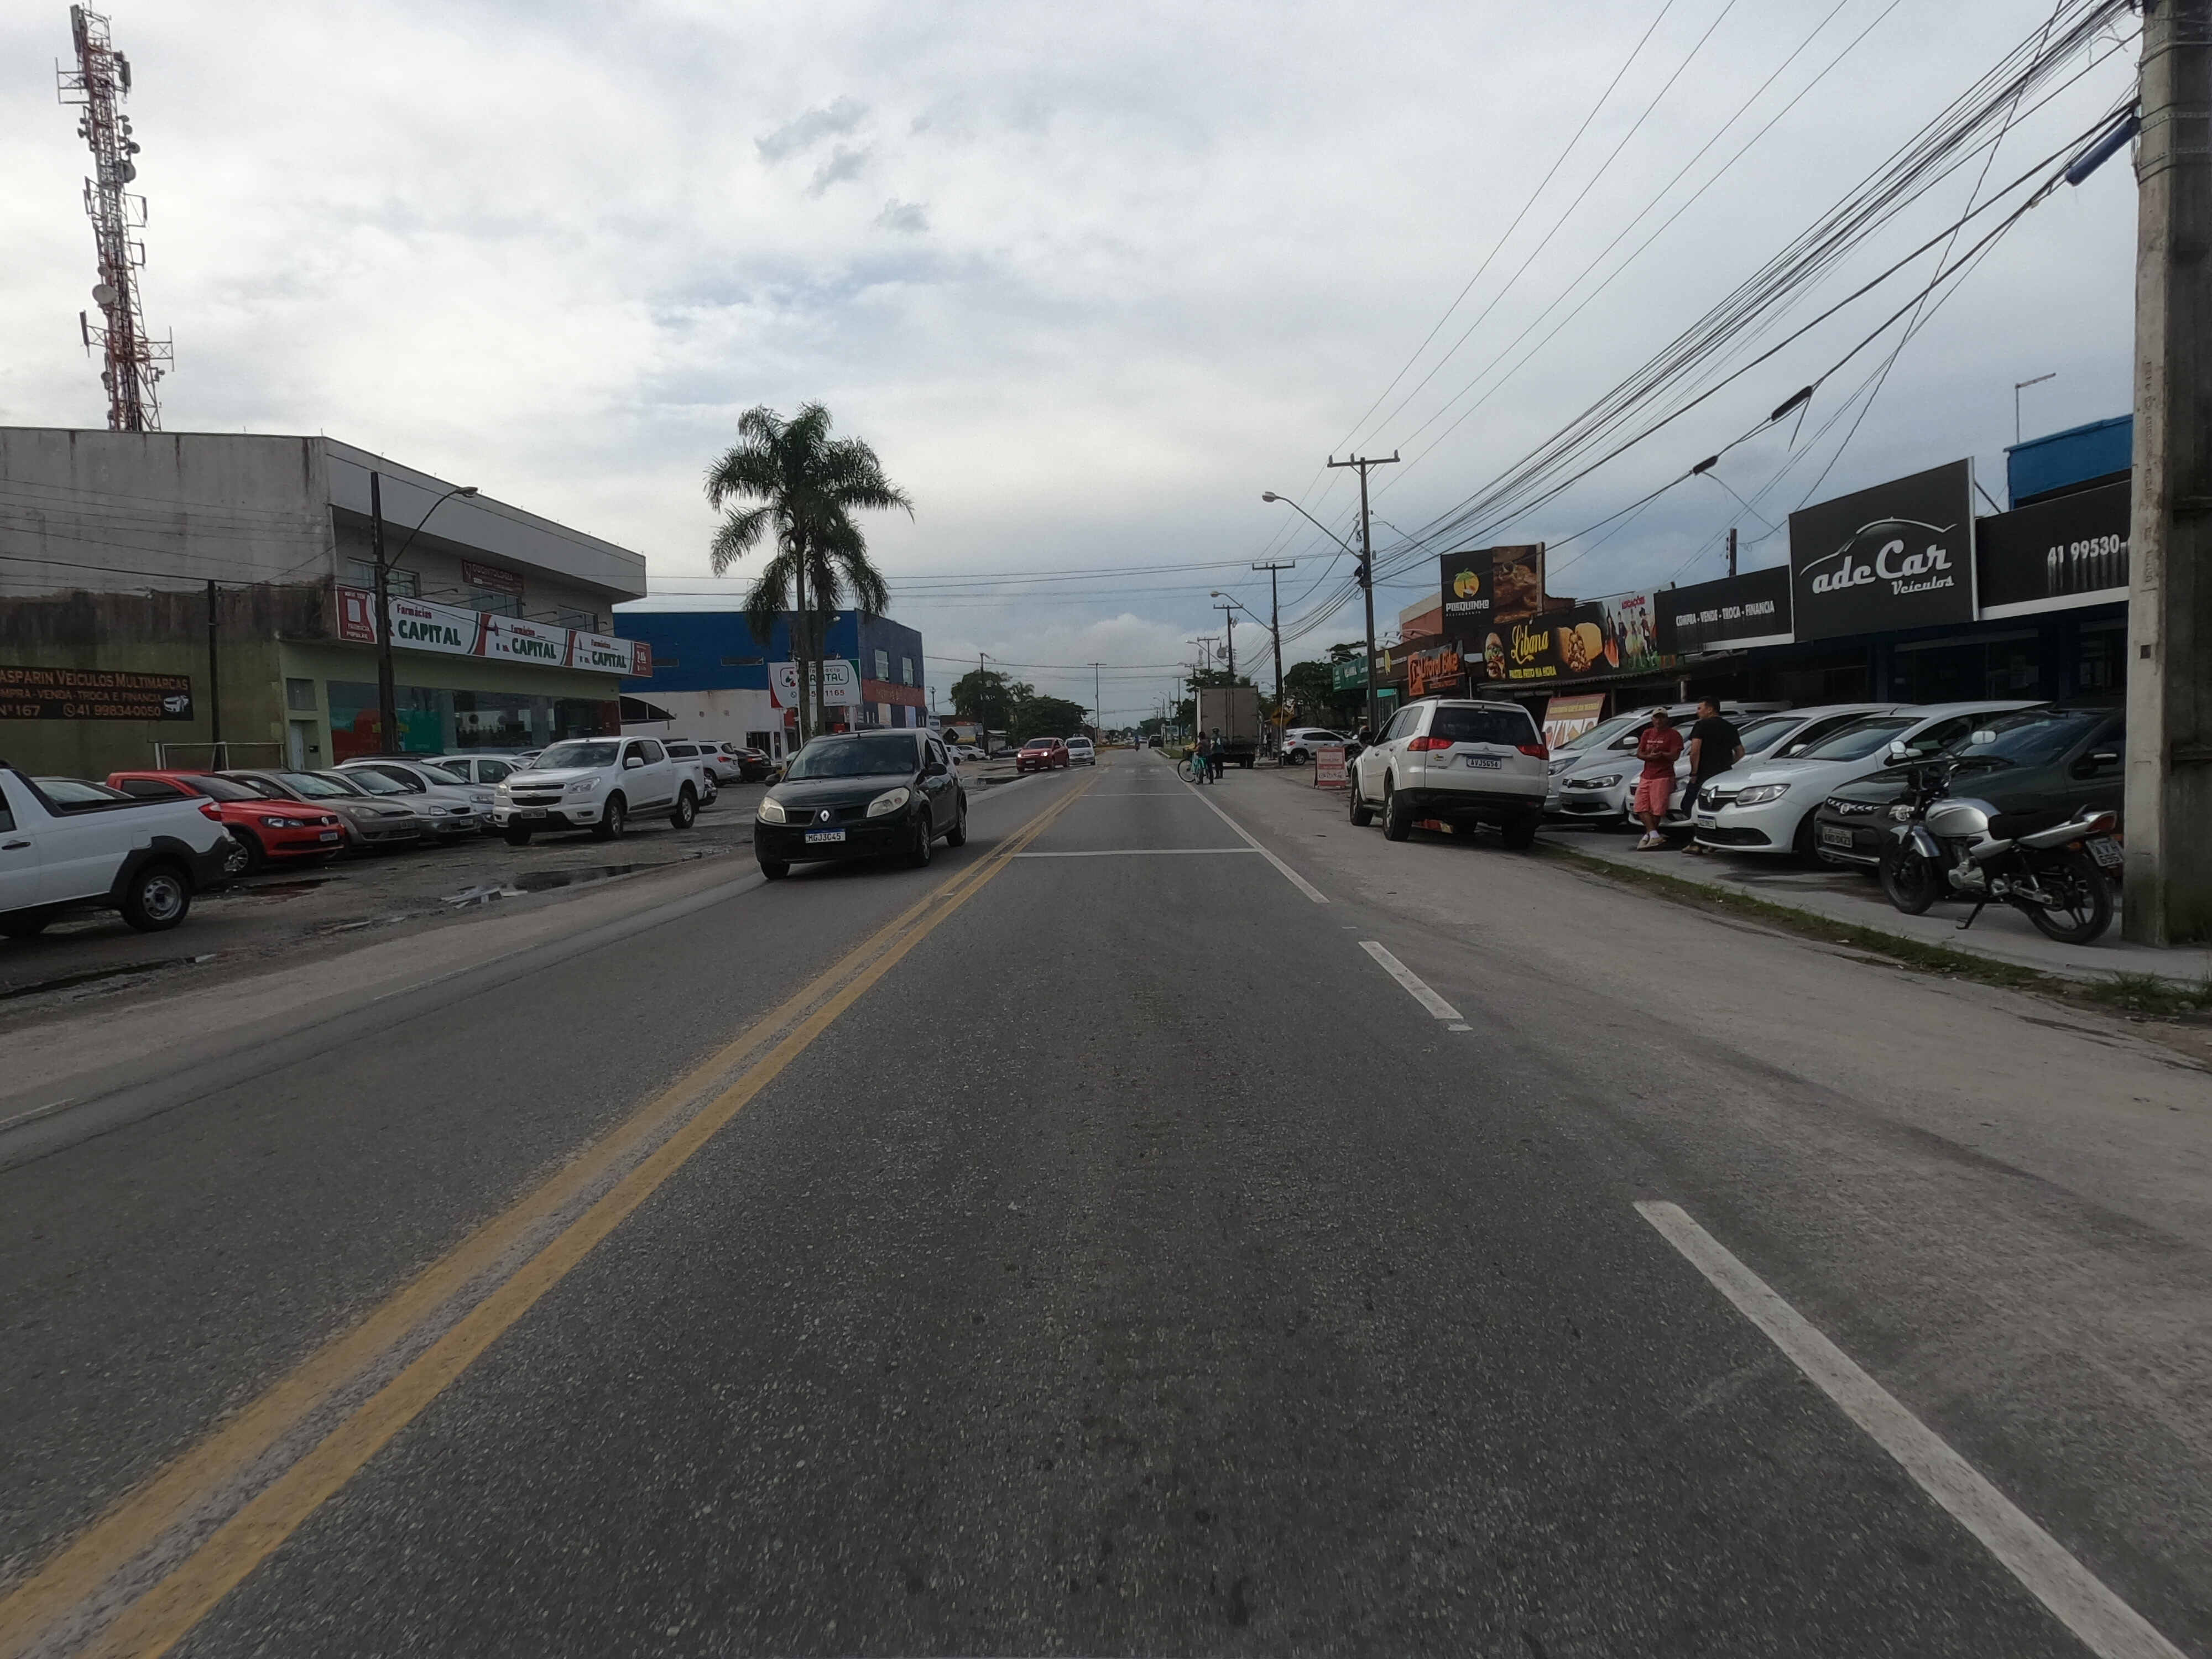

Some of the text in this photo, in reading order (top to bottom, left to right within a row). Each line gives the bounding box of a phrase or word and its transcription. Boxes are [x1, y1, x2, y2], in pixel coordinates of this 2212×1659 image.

[2047, 534, 2130, 564] 41 99530-
[1721, 606, 1741, 619] TROCA
[1745, 600, 1775, 616] FINANCIA
[398, 620, 461, 646] CAPITAL
[512, 638, 557, 659] CAPITAL
[592, 651, 627, 668] CAPITAL
[115, 673, 188, 690] MULTIMARCAS
[78, 691, 110, 700] TROCA
[16, 705, 40, 716] 167
[77, 705, 89, 716] 41
